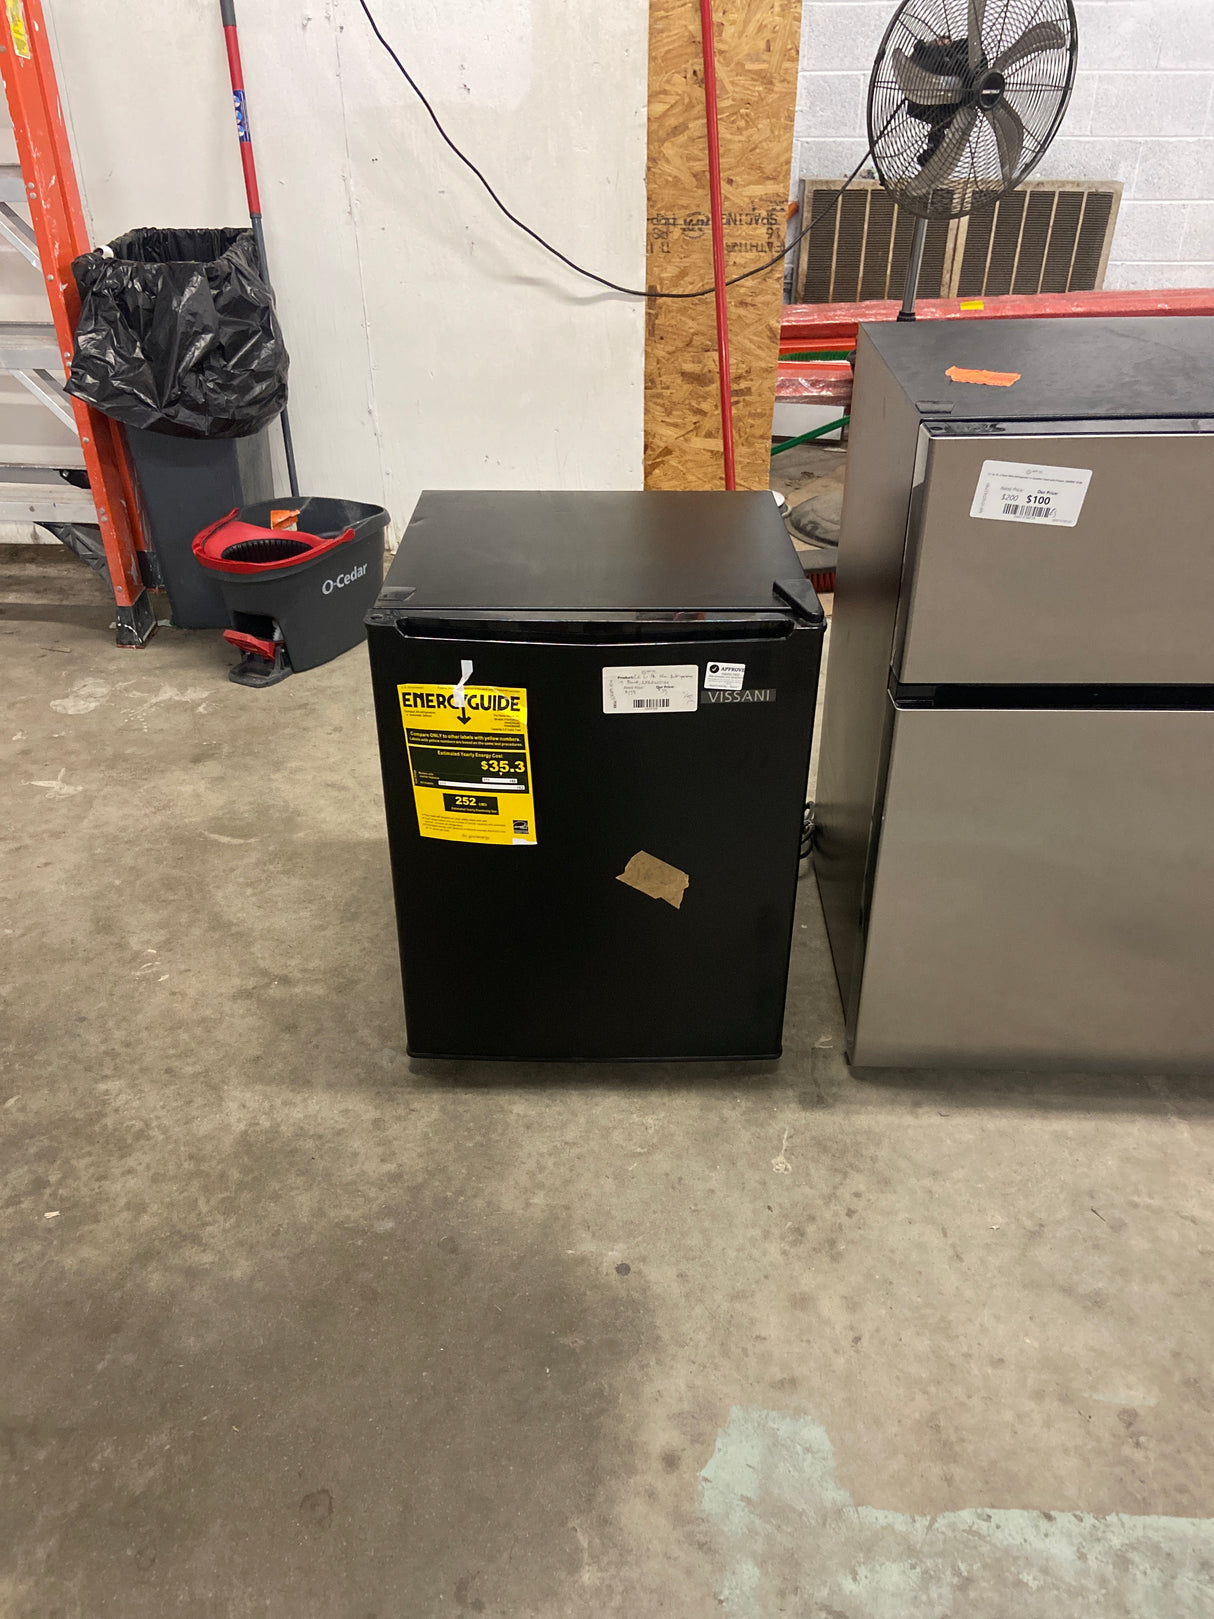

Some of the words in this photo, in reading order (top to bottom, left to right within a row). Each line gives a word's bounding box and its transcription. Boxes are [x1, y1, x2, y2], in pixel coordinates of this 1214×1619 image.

[1001, 494, 1019, 502] $200
[1026, 494, 1051, 505] $100
[322, 563, 368, 595] O-Cedar
[708, 689, 770, 703] VISSANI
[481, 760, 525, 773] $35.3
[455, 796, 477, 806] 252
